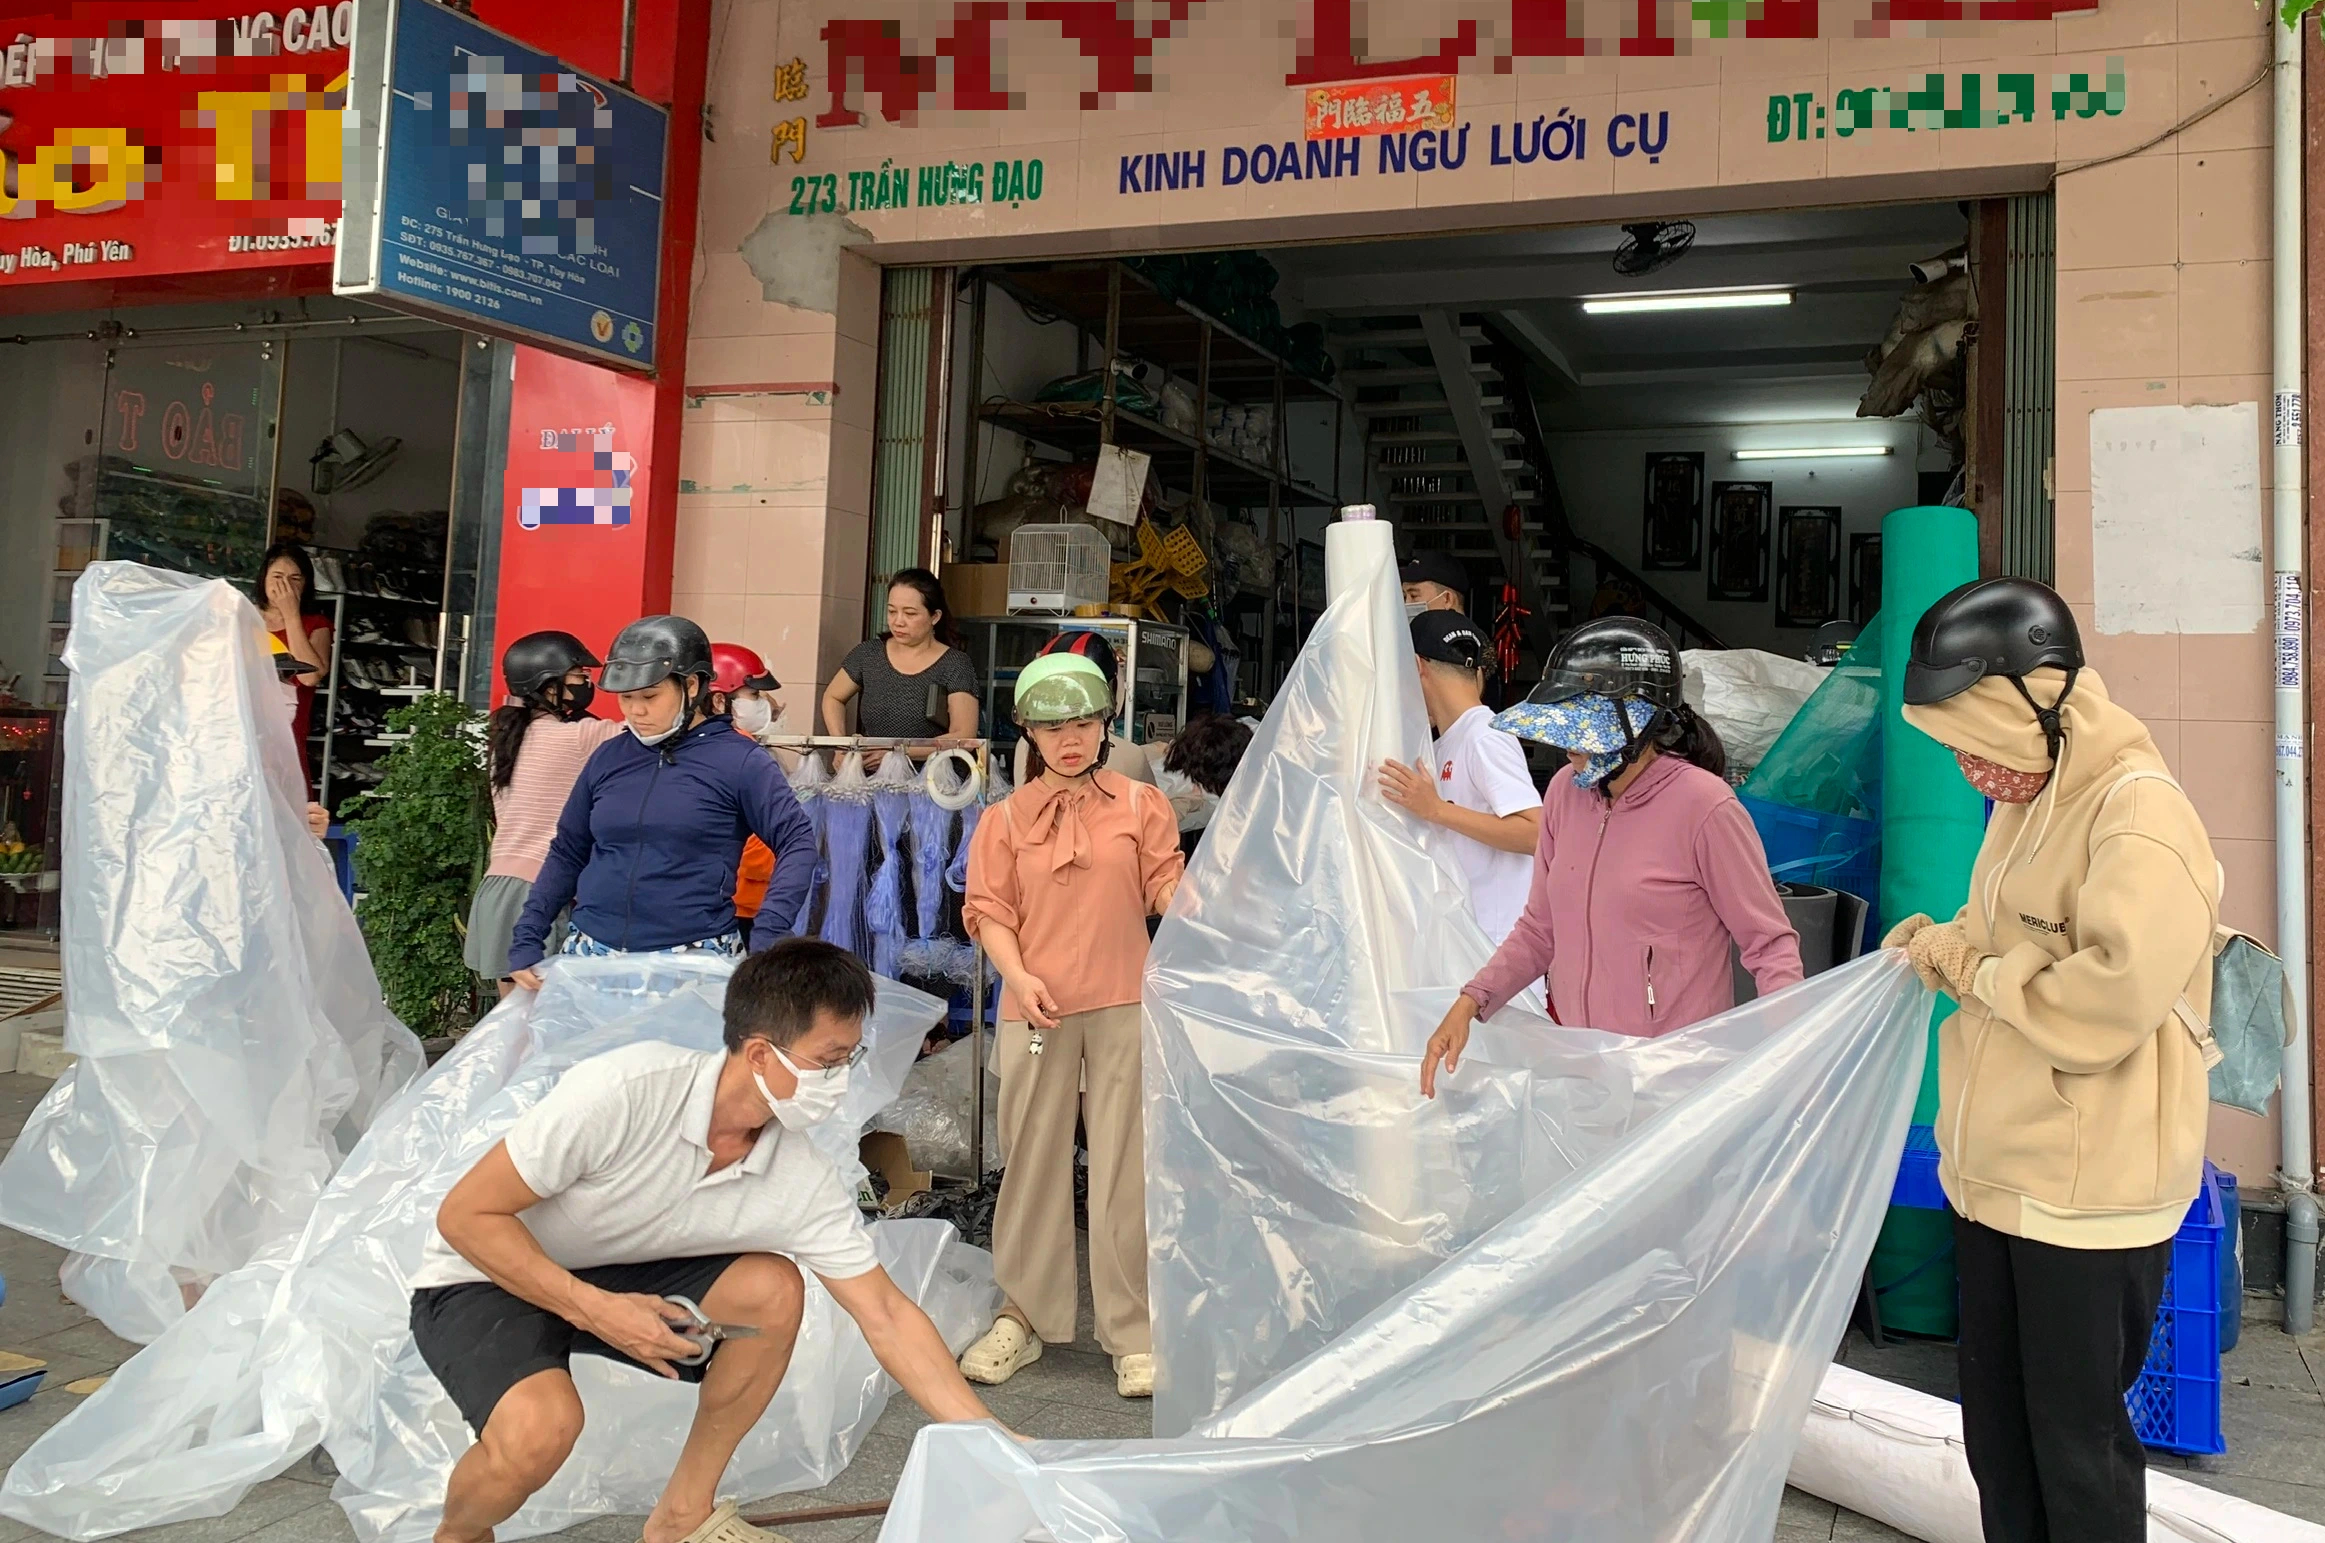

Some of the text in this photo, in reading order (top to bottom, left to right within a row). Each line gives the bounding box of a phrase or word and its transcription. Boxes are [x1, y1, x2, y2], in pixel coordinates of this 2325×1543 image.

[282, 0, 350, 53] CAO
[1766, 92, 1826, 143] ĐT:
[1119, 106, 1669, 194] KINH DOANH NGƯ LƯỚI CỤ
[789, 157, 1044, 215] 273 TRẦN HƯNG ĐẠO
[400, 231, 427, 248] SĐT:
[424, 223, 443, 238] 275
[20, 245, 60, 272] Hòa,
[62, 241, 97, 265] Phú
[100, 240, 132, 261] Yên
[399, 253, 447, 277] Website:
[397, 271, 500, 309] Hotline: 1900 2126
[1141, 630, 1177, 651] SHIMANO
[2282, 637, 2298, 686] 0984.758.890
